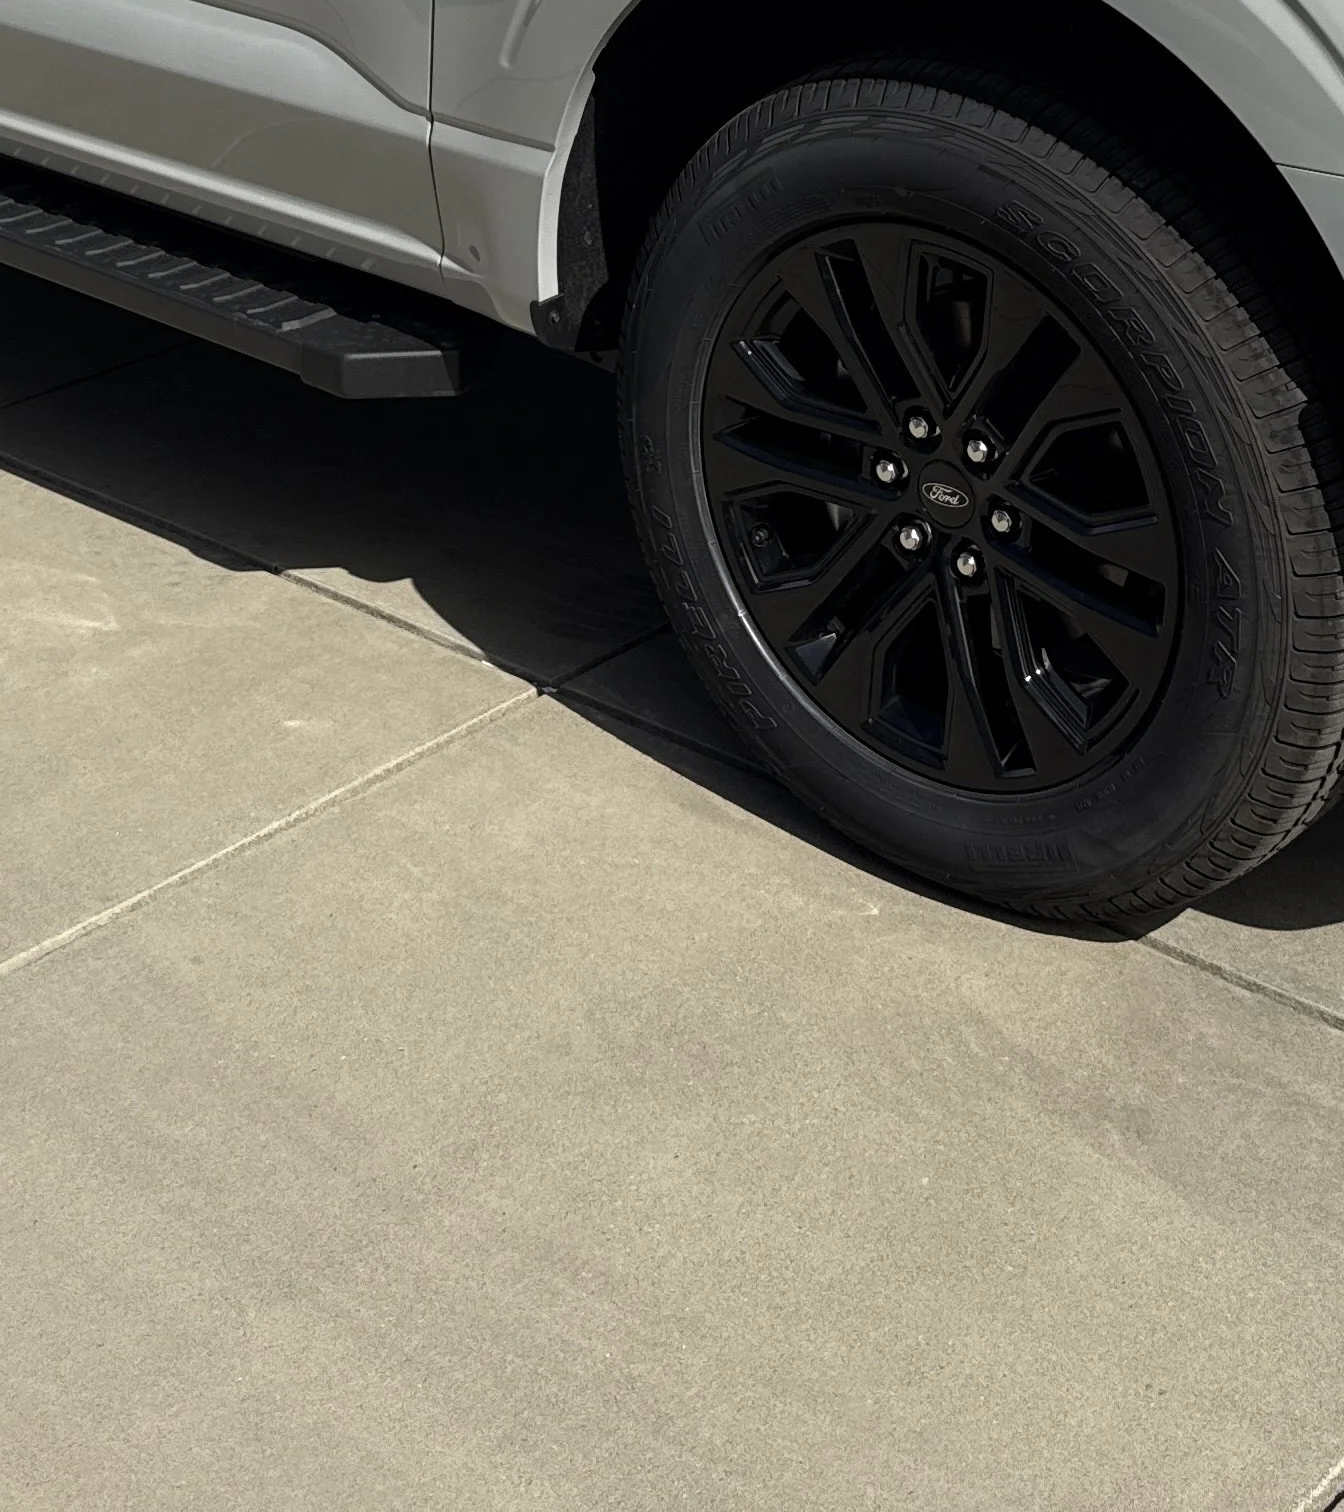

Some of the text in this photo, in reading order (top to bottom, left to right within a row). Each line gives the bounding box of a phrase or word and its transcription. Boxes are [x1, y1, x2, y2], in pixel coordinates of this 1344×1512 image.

[929, 485, 960, 505] Ford
[994, 198, 1245, 702] SCORPION ATR
